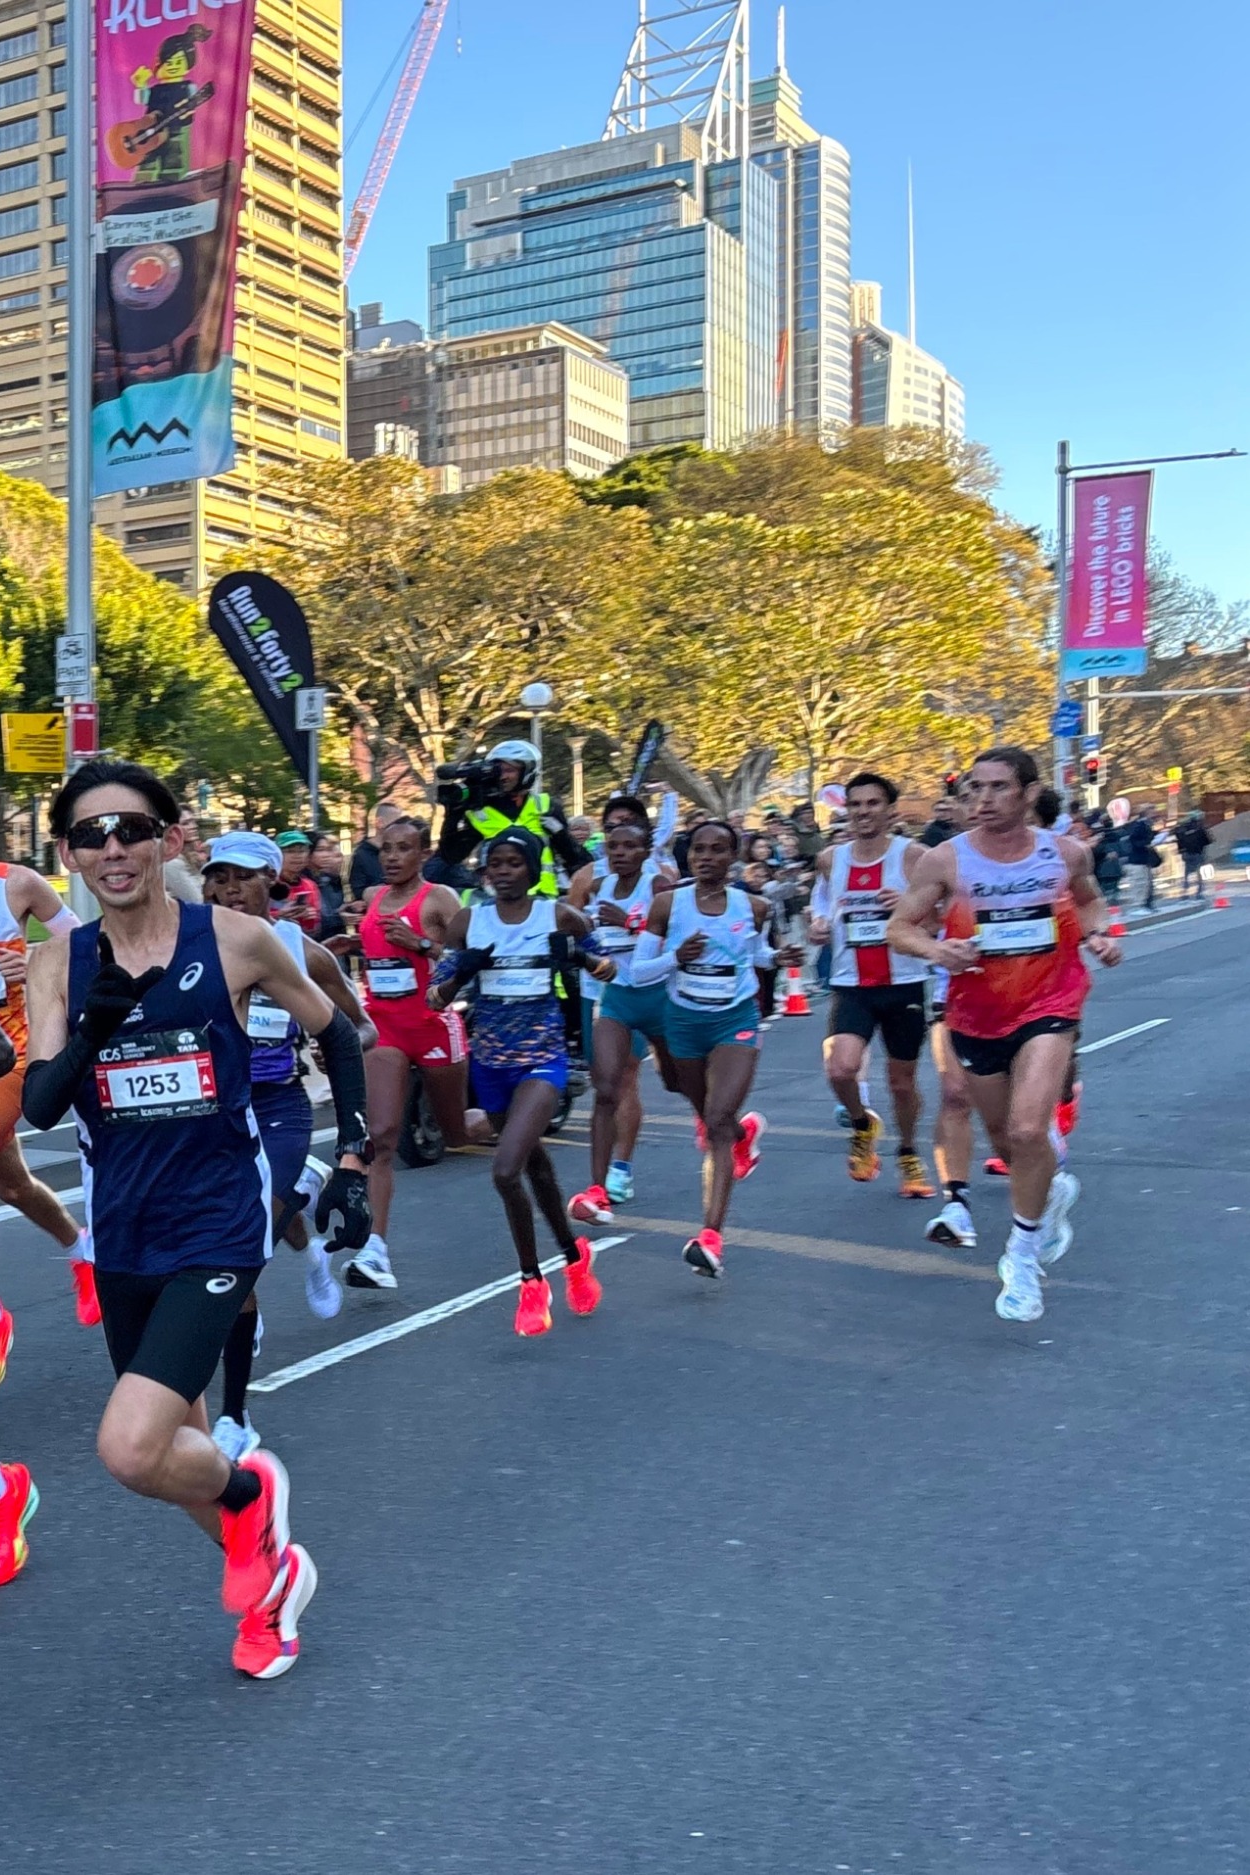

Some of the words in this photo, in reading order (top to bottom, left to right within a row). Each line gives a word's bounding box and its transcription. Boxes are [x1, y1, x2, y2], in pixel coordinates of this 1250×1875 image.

[1088, 494, 1111, 542] future
[1112, 504, 1136, 554] bricks
[1087, 545, 1110, 571] the
[1083, 575, 1108, 638] Discover
[1110, 609, 1132, 624] in
[177, 1044, 199, 1053] TATA
[125, 1071, 181, 1098] 1253
[202, 1074, 211, 1085] A
